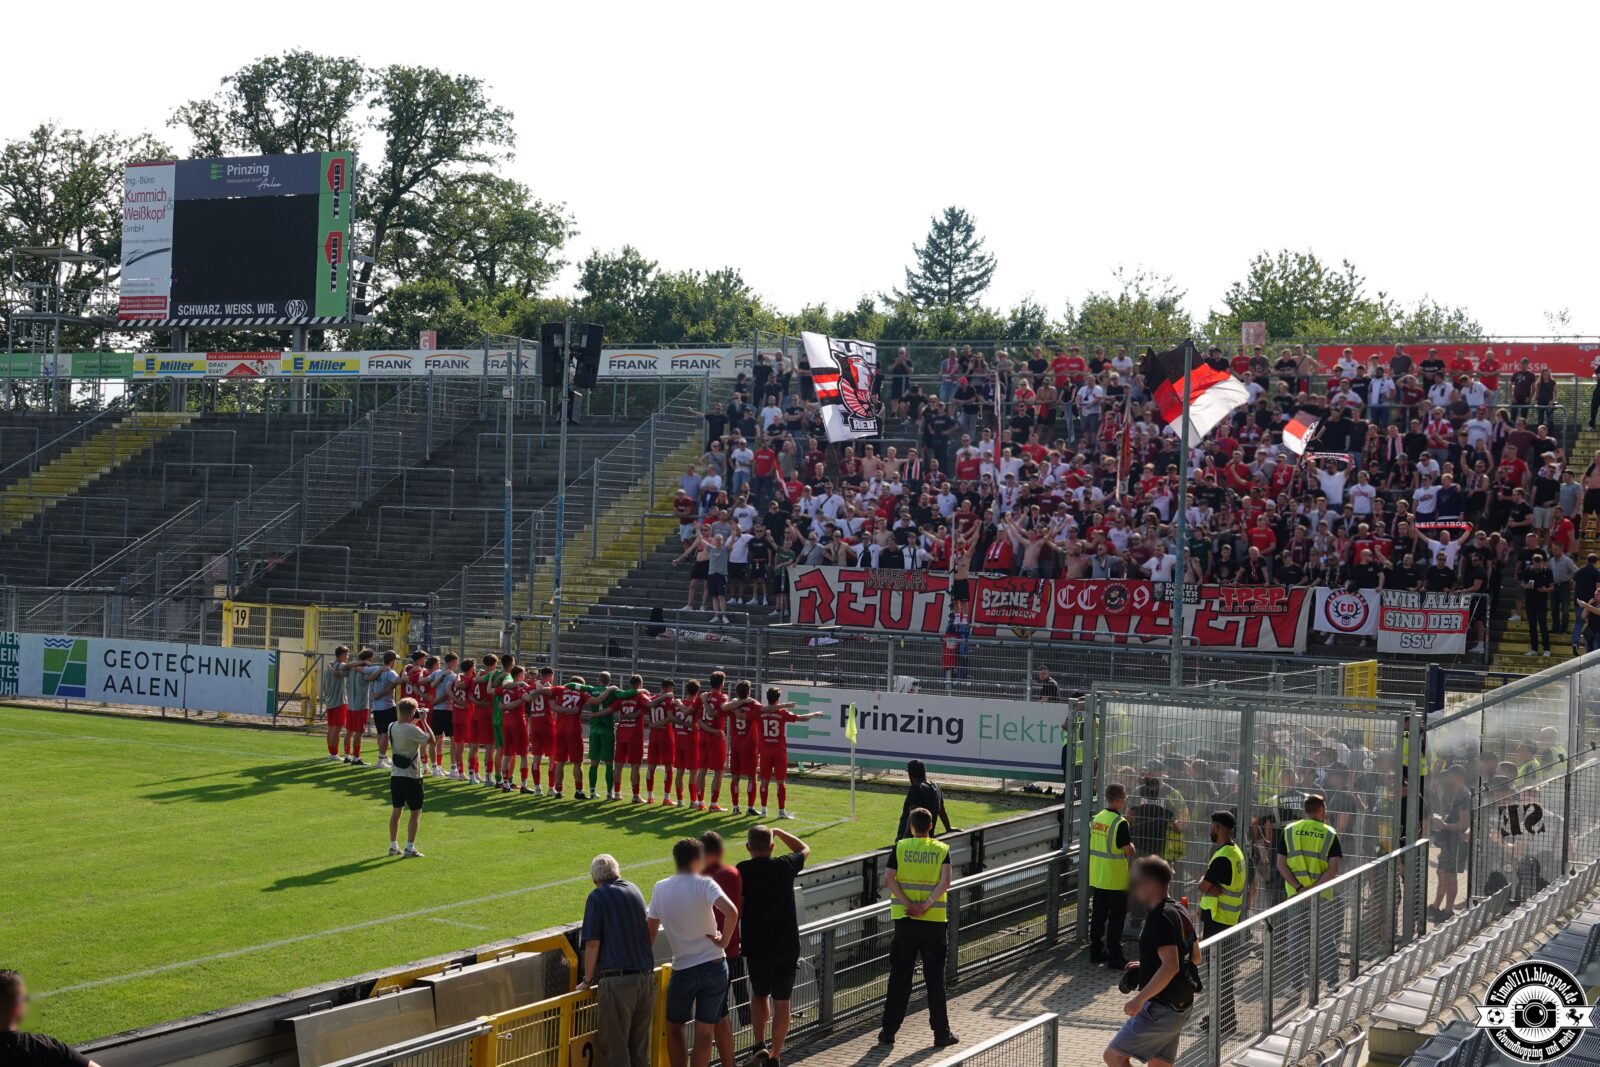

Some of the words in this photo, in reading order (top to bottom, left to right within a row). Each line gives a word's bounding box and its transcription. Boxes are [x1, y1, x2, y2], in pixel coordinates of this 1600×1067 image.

[226, 163, 270, 177] Prinzing
[125, 187, 167, 203] Kummich
[333, 163, 341, 219] TRAUB
[124, 205, 166, 223] Weißkopf
[123, 225, 145, 233] GmbH
[330, 236, 340, 293] TRAUB
[177, 304, 222, 316] SCHWARZ.
[225, 303, 254, 315] WEISS.
[257, 303, 277, 315] WIR.
[160, 360, 194, 371] Miller
[309, 359, 346, 370] Miller
[368, 360, 412, 369] FRANK
[425, 360, 469, 369] FRANK
[609, 360, 658, 370] FRANK
[671, 360, 721, 369] FRANK
[981, 588, 1030, 609] SZENE
[1031, 593, 1042, 613] E
[1382, 589, 1421, 609] WIR
[1423, 591, 1472, 609] ALLE
[234, 609, 247, 627] 19
[1384, 612, 1426, 630] SIND
[1427, 613, 1463, 630] DER
[378, 618, 393, 636] 20
[1400, 633, 1436, 649] SSV
[0, 648, 19, 662] EIN
[103, 648, 253, 679] GEOTECHNIK
[0, 665, 19, 679] TES
[103, 675, 179, 698] AALEN
[530, 694, 545, 712] 19
[650, 706, 665, 724] 10
[763, 719, 780, 738] 13
[839, 703, 964, 745] Prinzing
[1295, 830, 1325, 839] CENTUS
[903, 849, 940, 864] SECURITY
